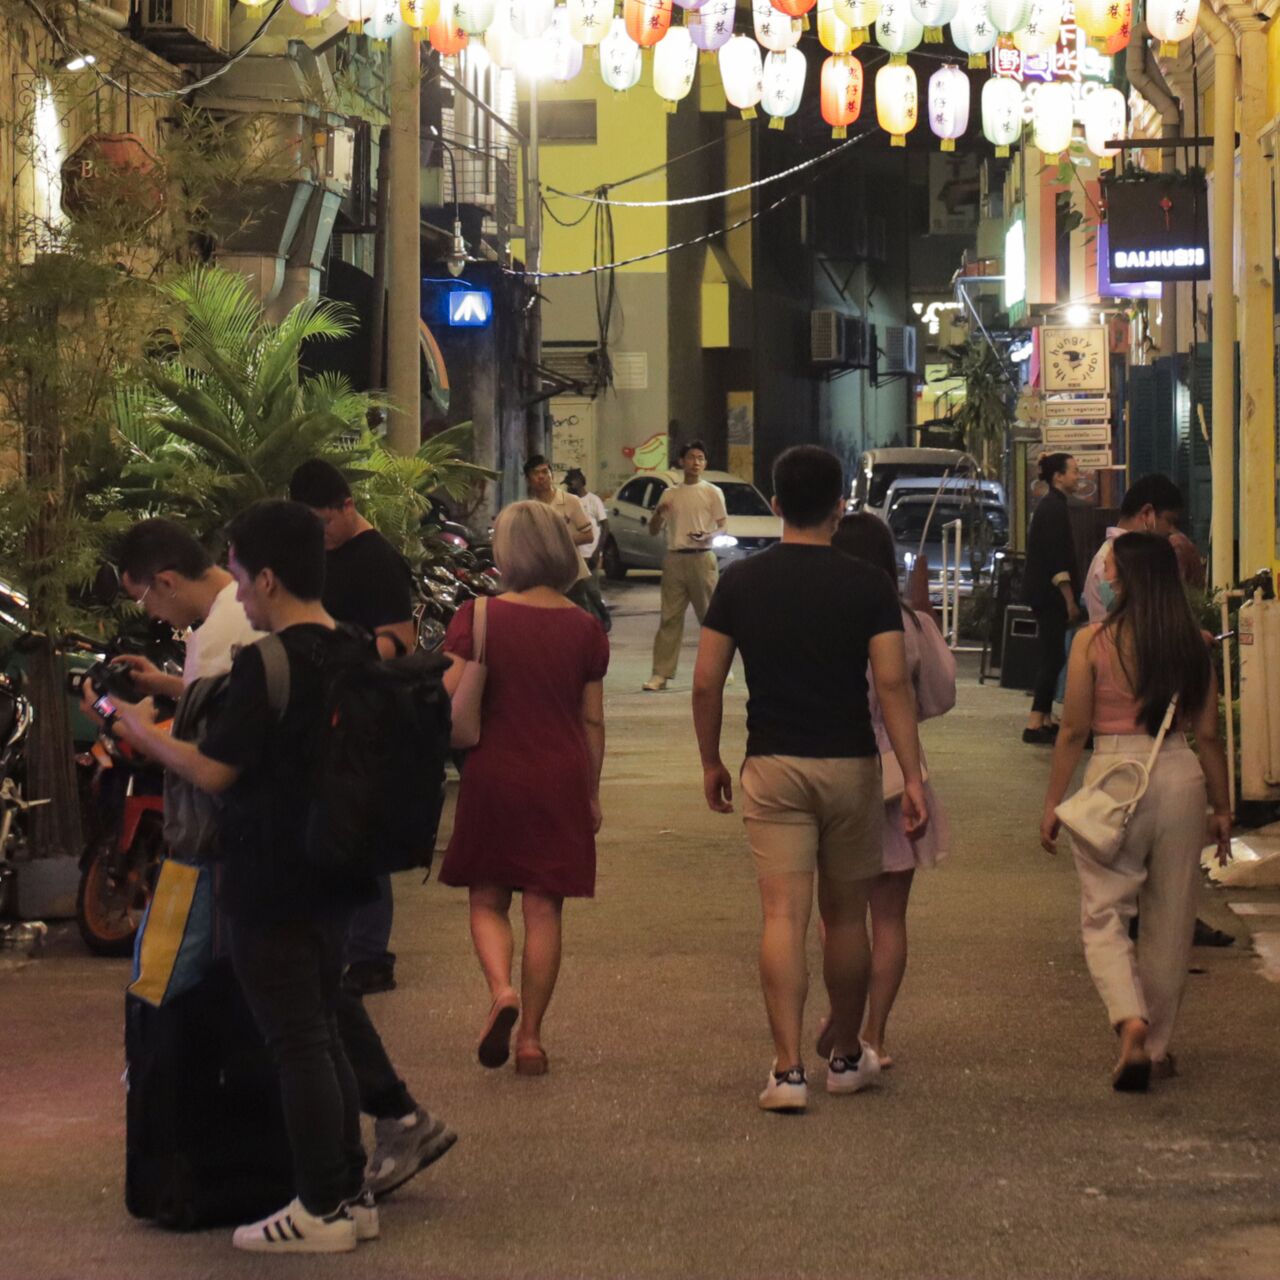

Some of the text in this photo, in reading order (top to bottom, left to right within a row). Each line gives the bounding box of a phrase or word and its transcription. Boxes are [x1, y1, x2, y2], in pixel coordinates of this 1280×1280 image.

[1049, 336, 1100, 382] the hungry tapir
